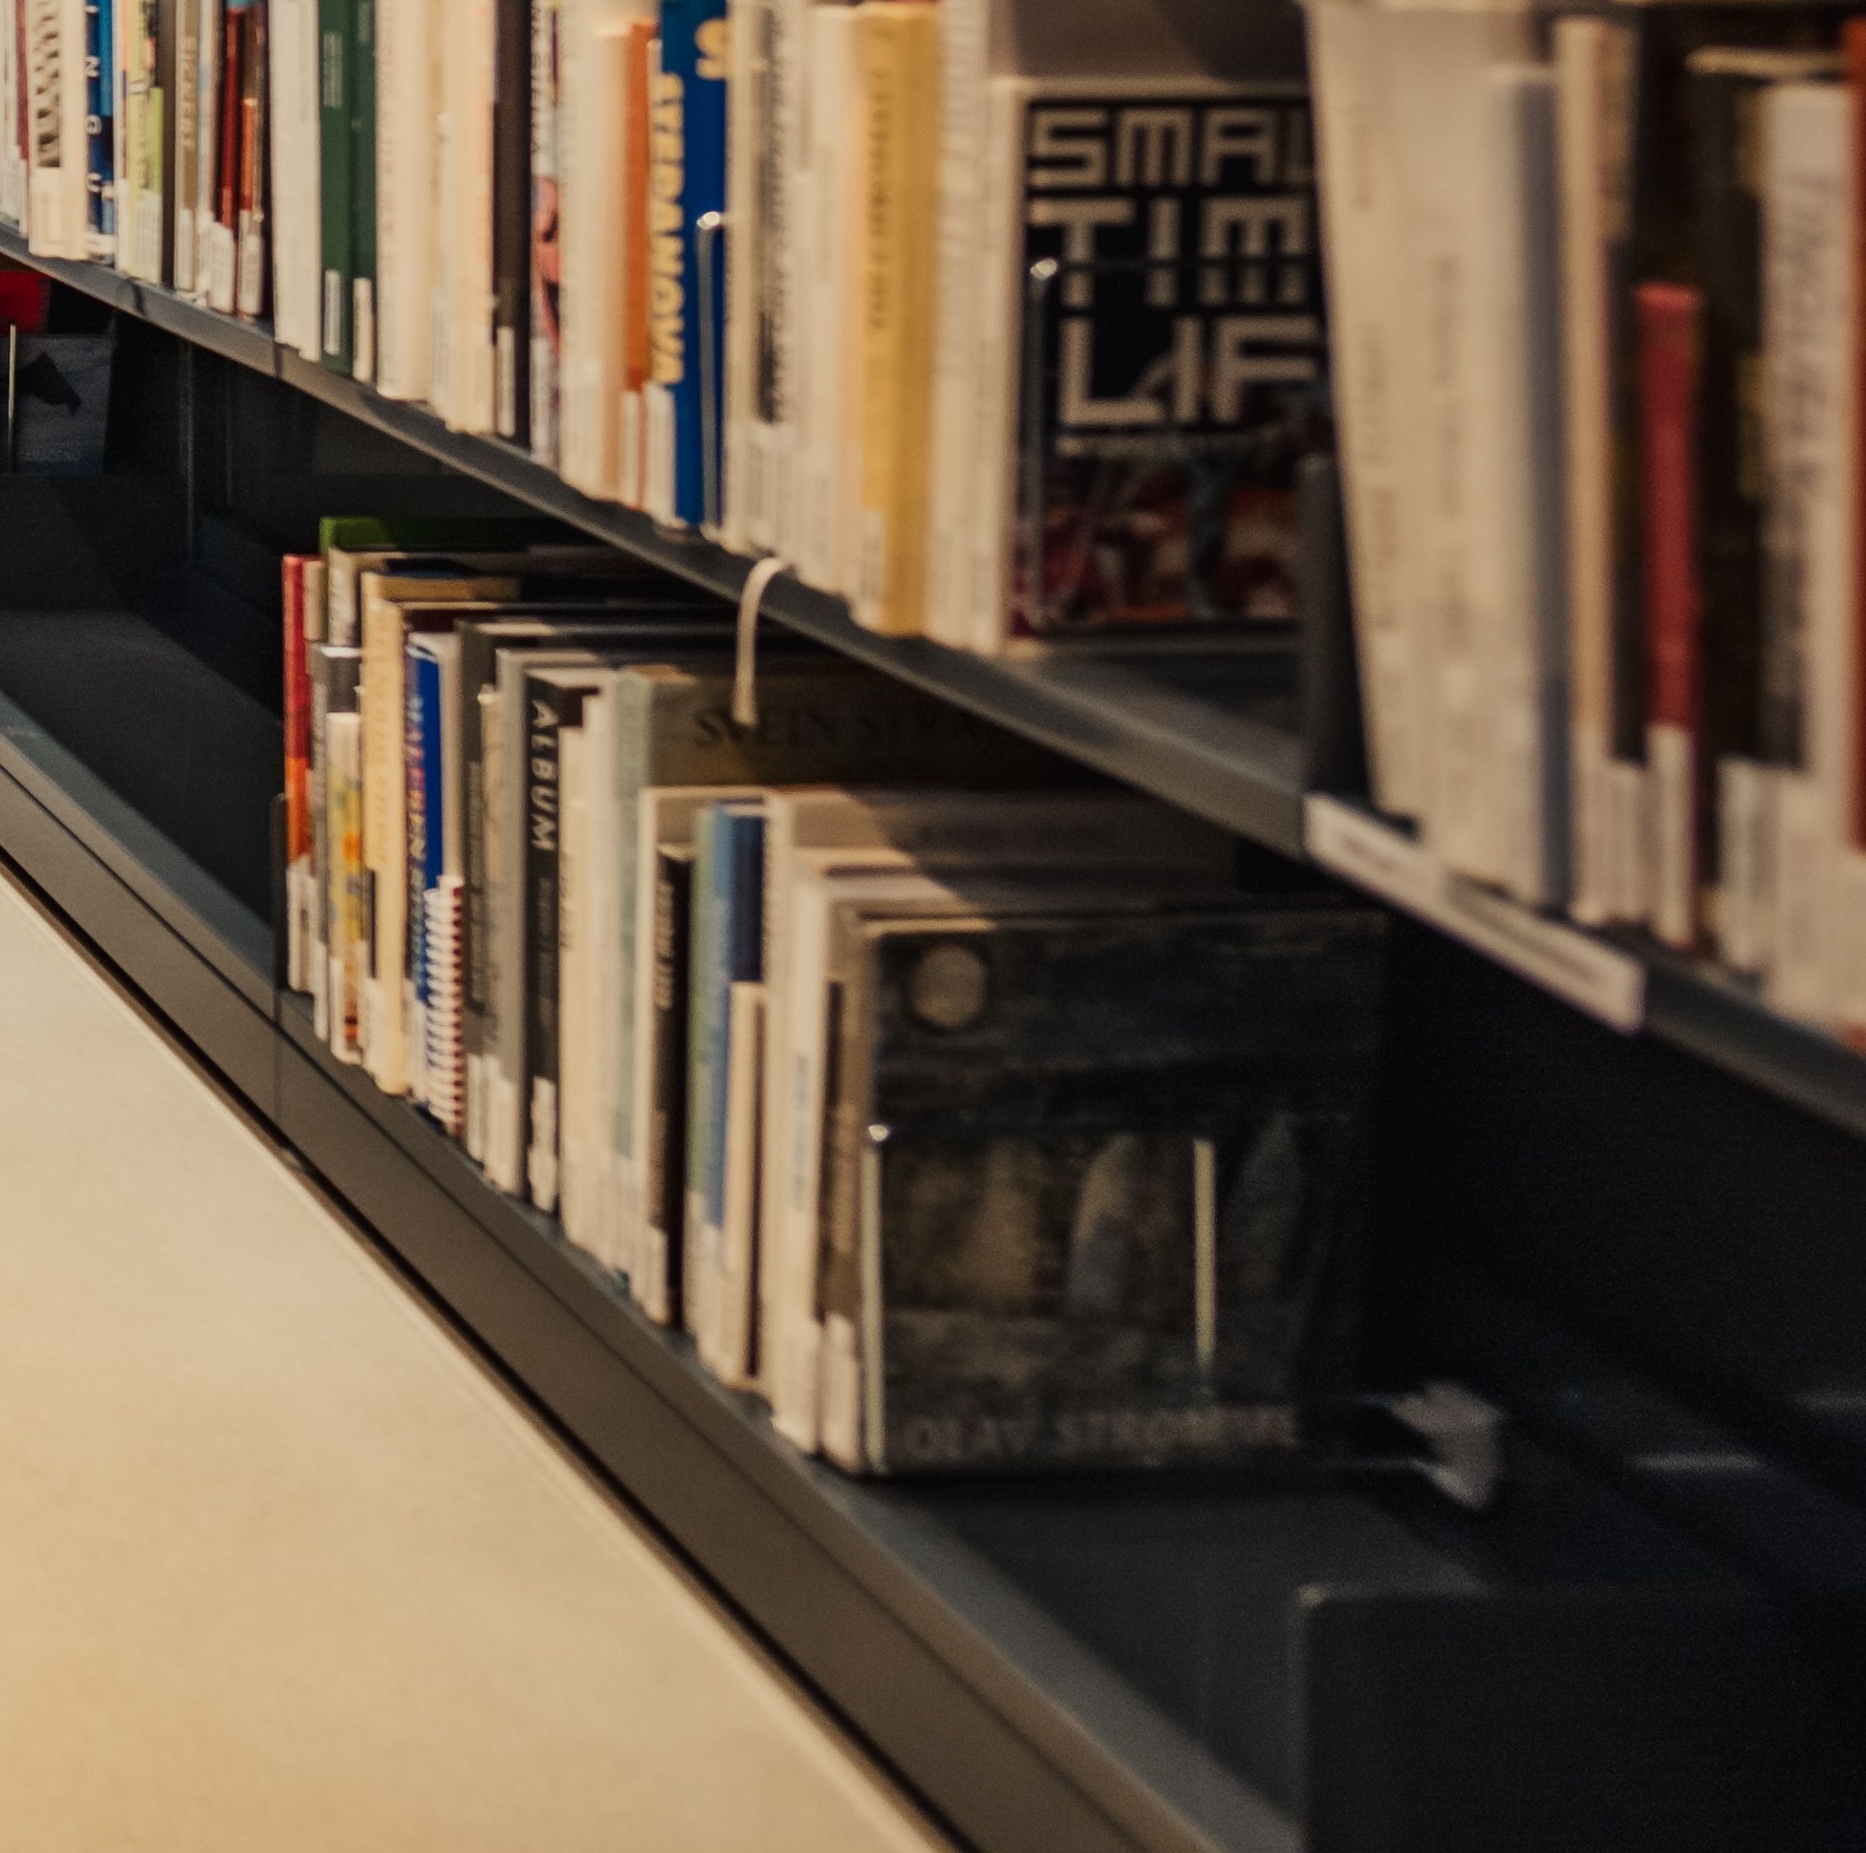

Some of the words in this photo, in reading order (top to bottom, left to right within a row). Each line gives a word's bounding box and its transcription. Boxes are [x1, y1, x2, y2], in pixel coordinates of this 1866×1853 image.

[1028, 107, 1312, 188] SMAL
[1031, 197, 1309, 306] TIM
[1057, 315, 1318, 427] LIF
[531, 699, 562, 851] ALBUM
